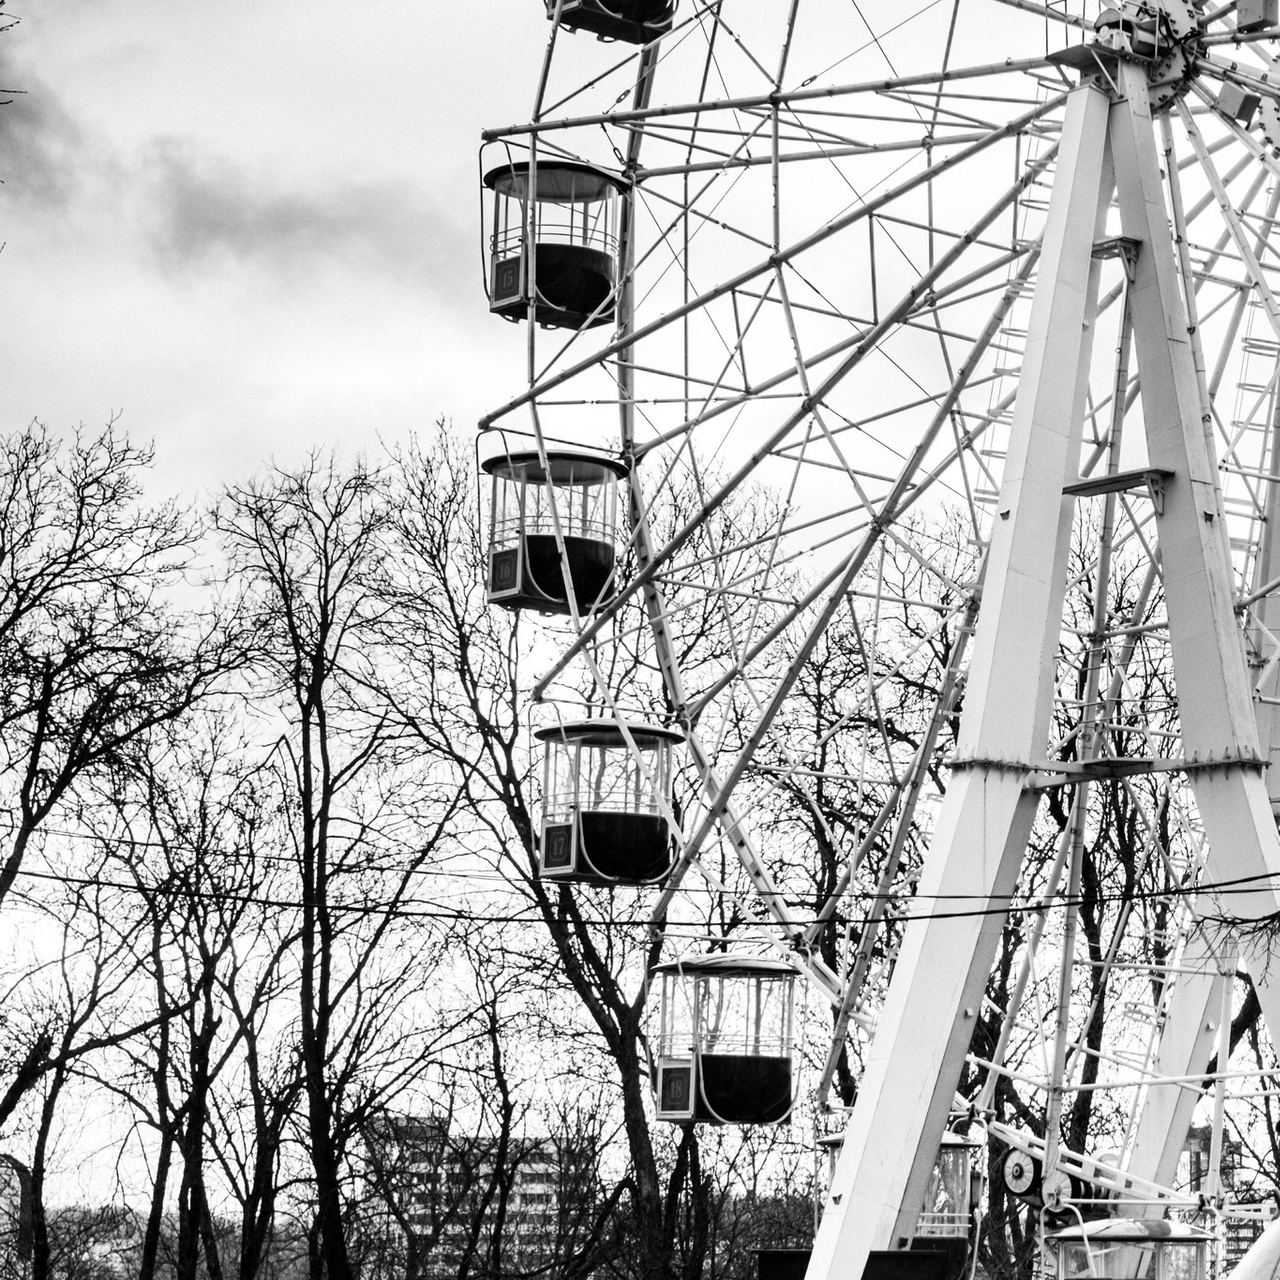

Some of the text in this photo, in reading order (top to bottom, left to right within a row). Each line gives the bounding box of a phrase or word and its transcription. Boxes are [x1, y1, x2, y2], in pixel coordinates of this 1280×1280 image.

[503, 270, 513, 288] 15
[500, 561, 511, 579] 16
[553, 837, 565, 856] 17
[670, 1080, 682, 1098] 18
